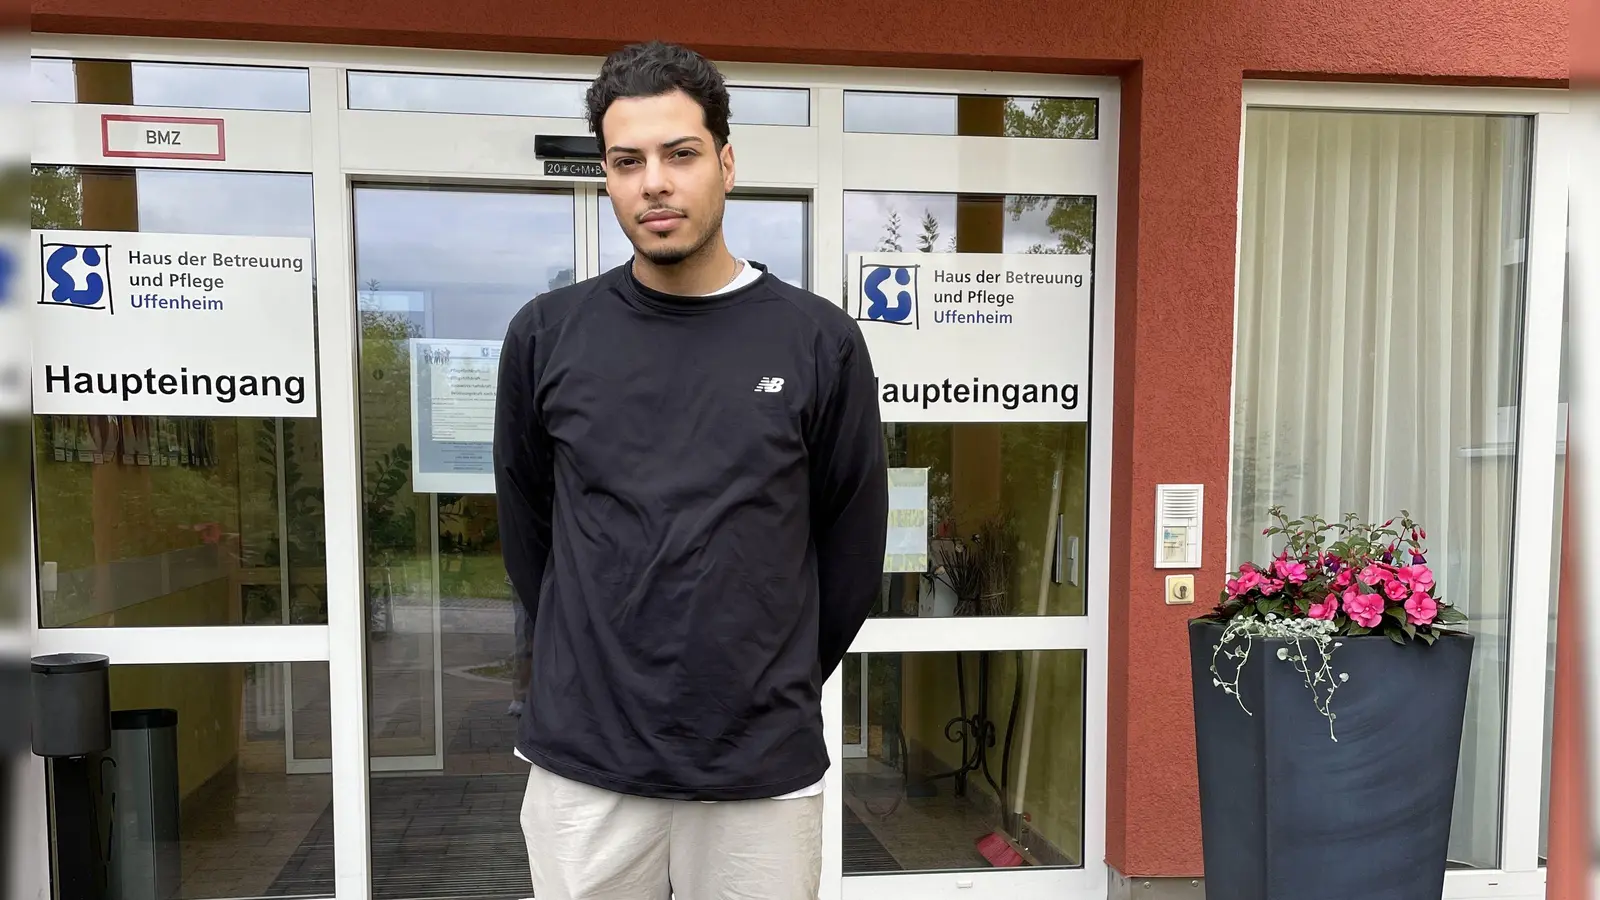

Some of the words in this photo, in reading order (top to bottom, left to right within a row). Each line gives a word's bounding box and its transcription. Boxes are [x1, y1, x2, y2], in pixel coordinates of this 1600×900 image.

[146, 130, 181, 145] BMZ
[128, 250, 172, 266] Haus
[177, 250, 207, 267] der
[212, 252, 303, 273] Betreuung
[129, 272, 163, 287] und
[169, 272, 224, 292] Pflege
[934, 269, 972, 284] Haus
[976, 269, 1001, 284] der
[1005, 270, 1083, 288] Betreuung
[130, 293, 224, 311] Uffenheim
[934, 289, 963, 304] und
[967, 289, 1015, 308] Pflege
[934, 309, 1013, 325] Uffenheim
[45, 364, 305, 404] Haupteingang
[875, 377, 1079, 410] aupteingang
